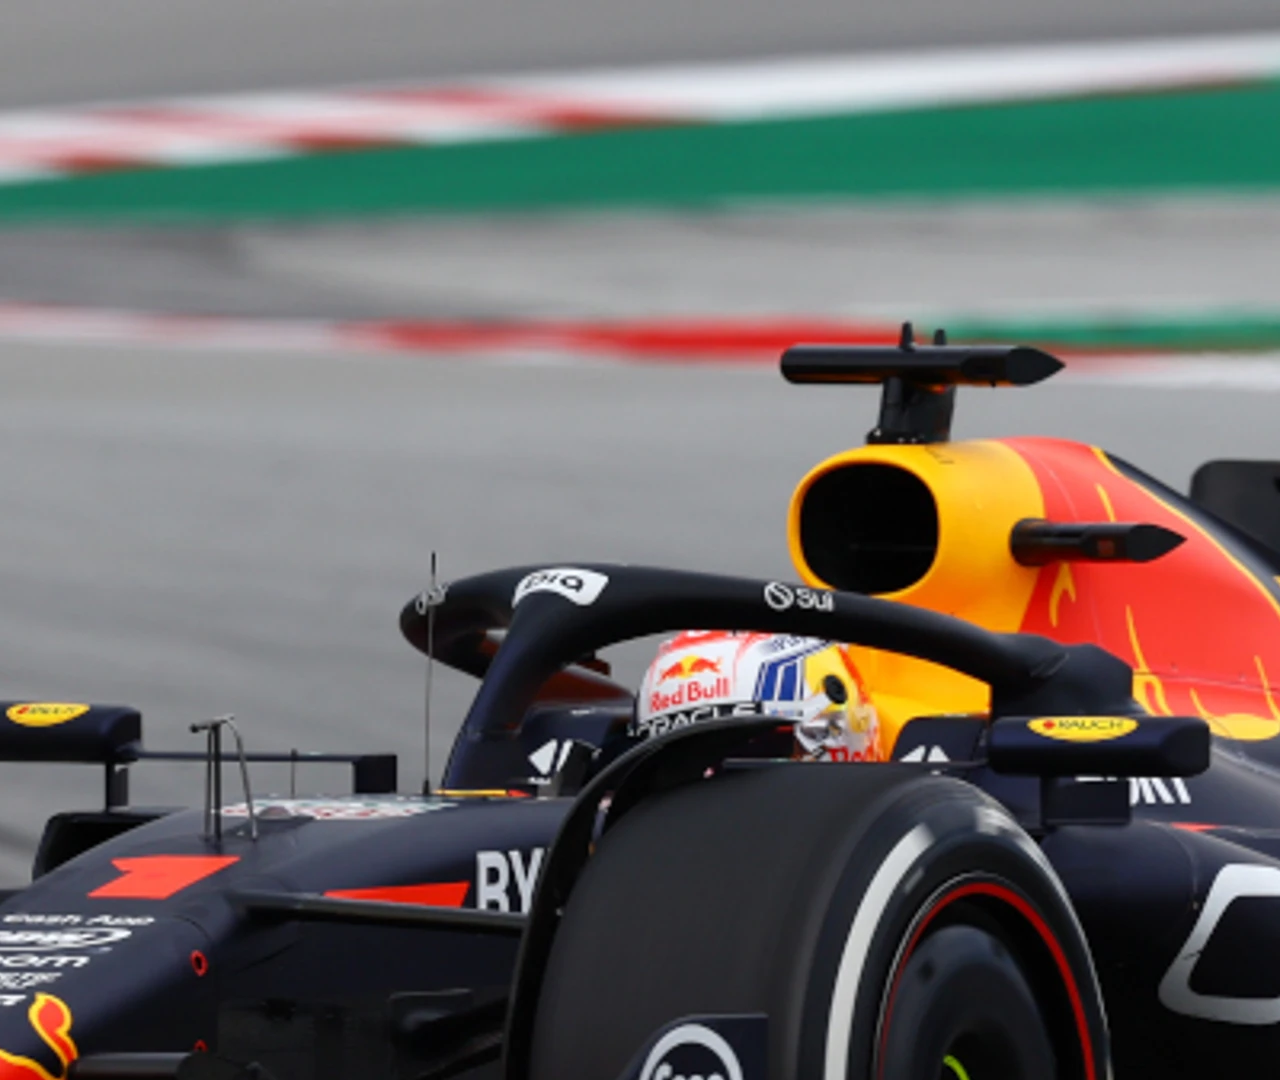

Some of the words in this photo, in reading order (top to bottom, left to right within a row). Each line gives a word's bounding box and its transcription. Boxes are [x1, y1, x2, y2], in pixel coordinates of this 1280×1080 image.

[650, 686, 684, 713] Red
[687, 678, 730, 706] Bull
[87, 854, 241, 900] 1
